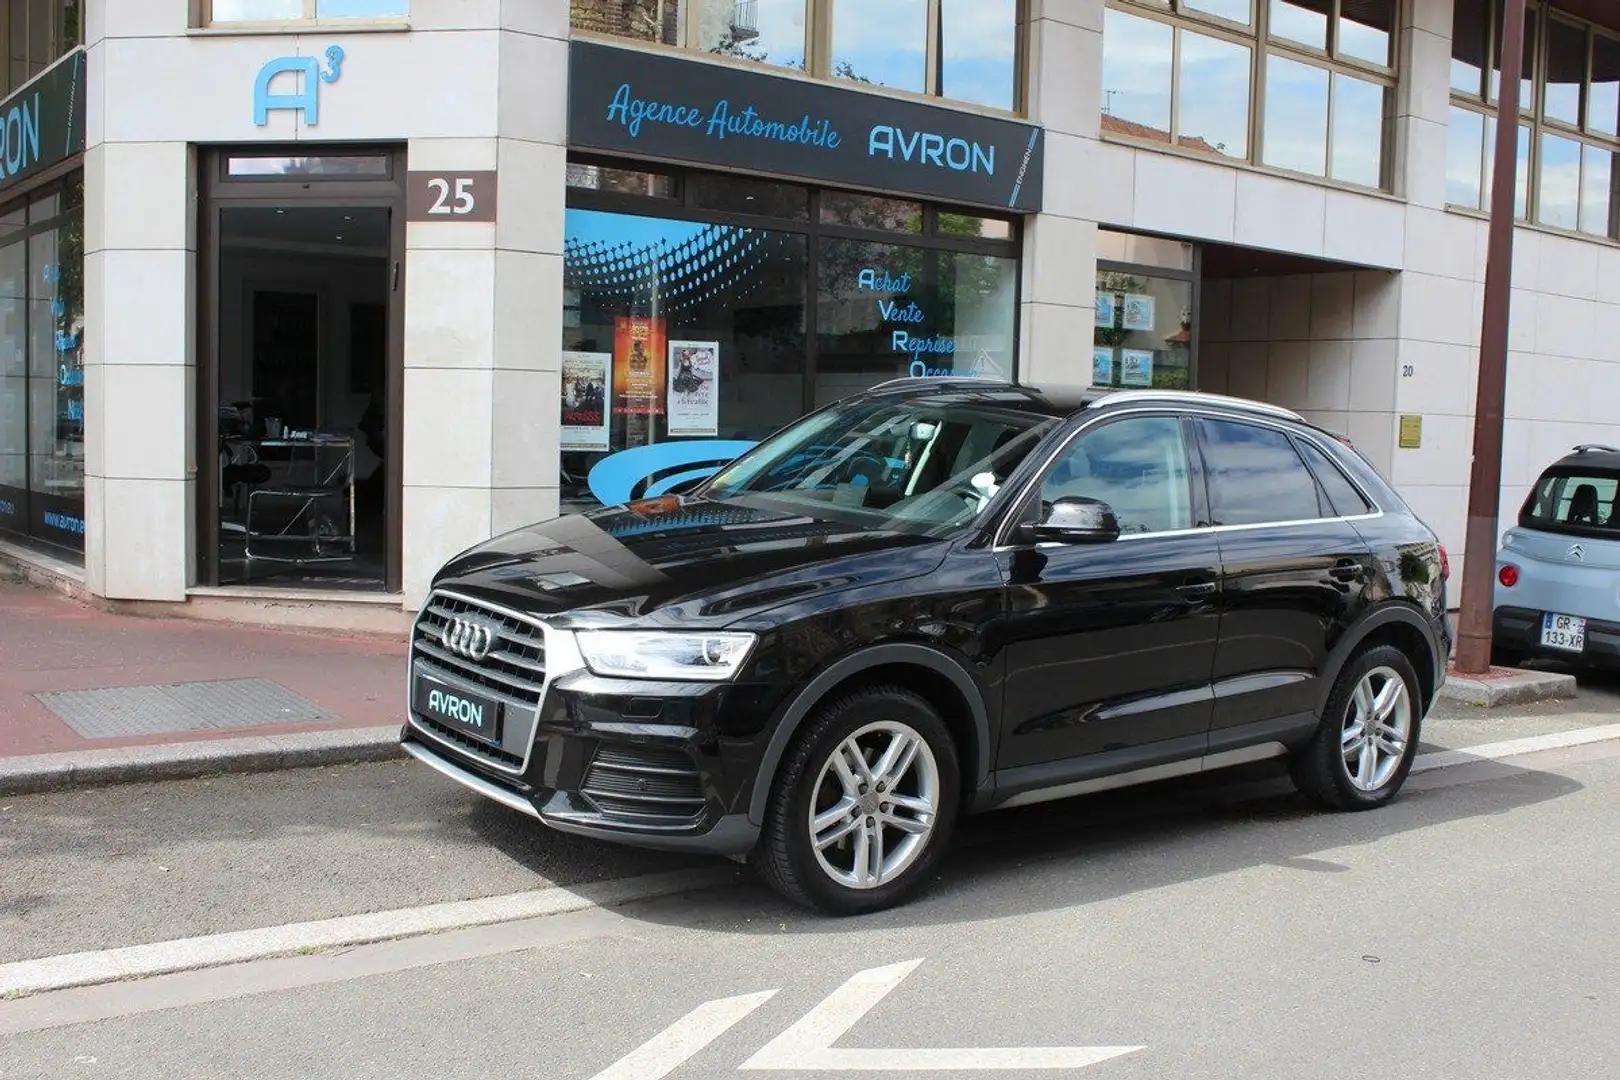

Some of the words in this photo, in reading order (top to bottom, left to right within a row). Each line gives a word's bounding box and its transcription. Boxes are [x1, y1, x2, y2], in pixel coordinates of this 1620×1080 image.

[606, 84, 702, 137] Agence
[706, 100, 841, 149] Automobile
[869, 125, 995, 176] AVRON
[427, 177, 474, 214] 25
[858, 268, 912, 293] Achat
[877, 299, 925, 323] Vente
[892, 330, 957, 361] Reprise
[1402, 364, 1414, 377] 20
[1545, 630, 1584, 648] 133-XR
[428, 689, 482, 728] AVRON
